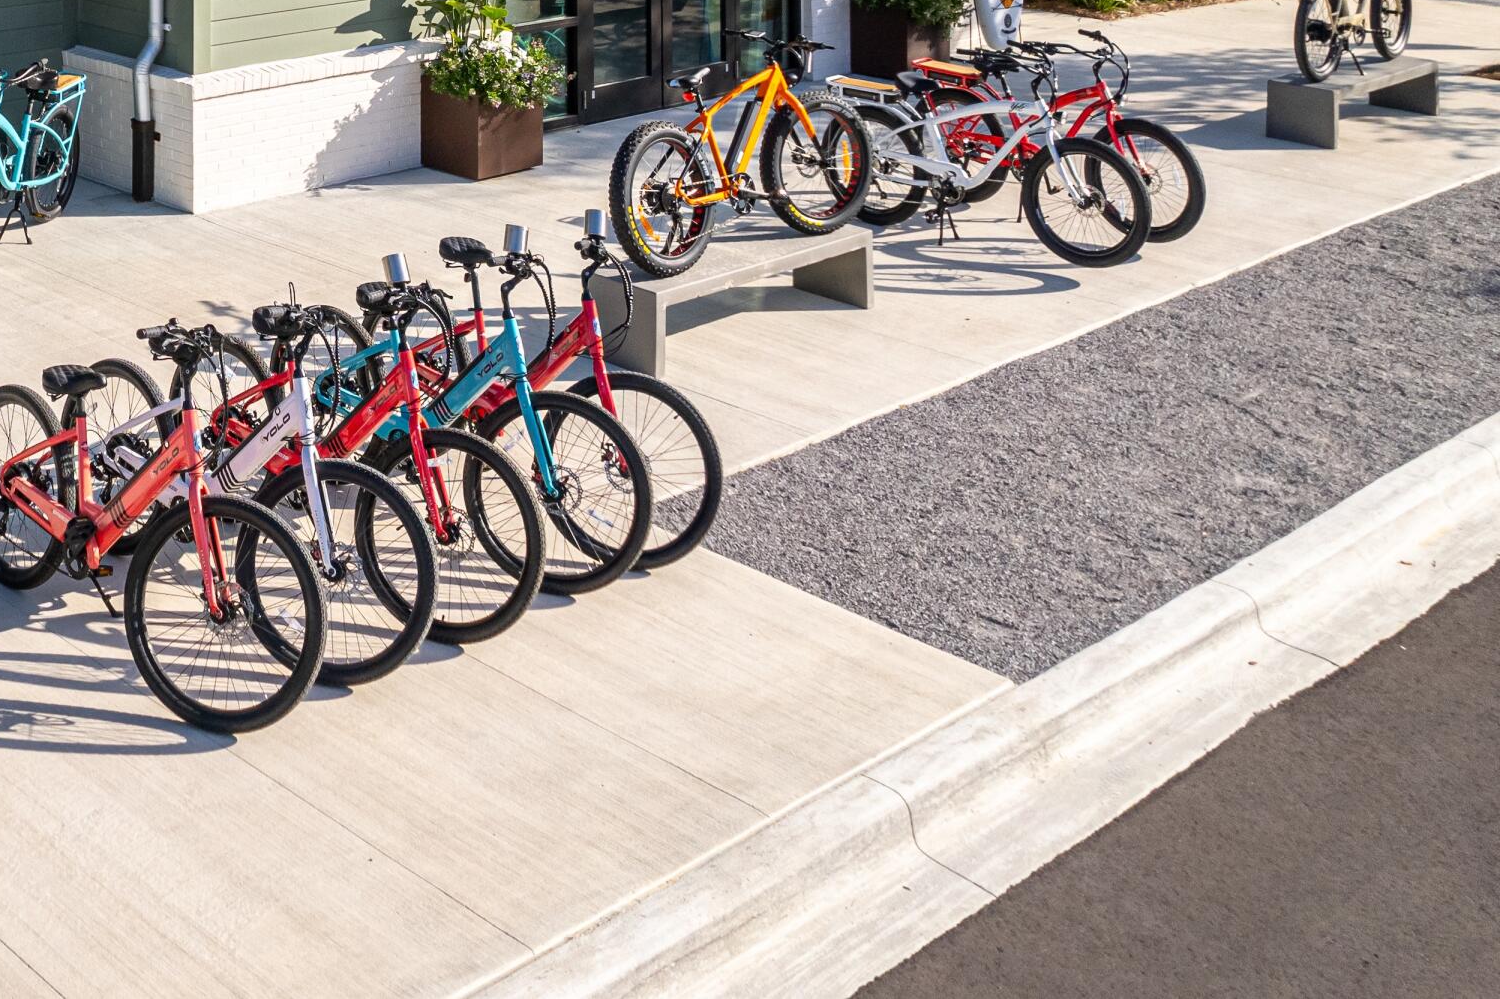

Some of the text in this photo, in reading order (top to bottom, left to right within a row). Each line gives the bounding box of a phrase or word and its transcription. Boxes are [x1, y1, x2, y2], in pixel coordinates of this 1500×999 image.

[476, 352, 504, 378] YOLO
[263, 413, 291, 441] YOLO
[153, 447, 179, 474] YOLO
